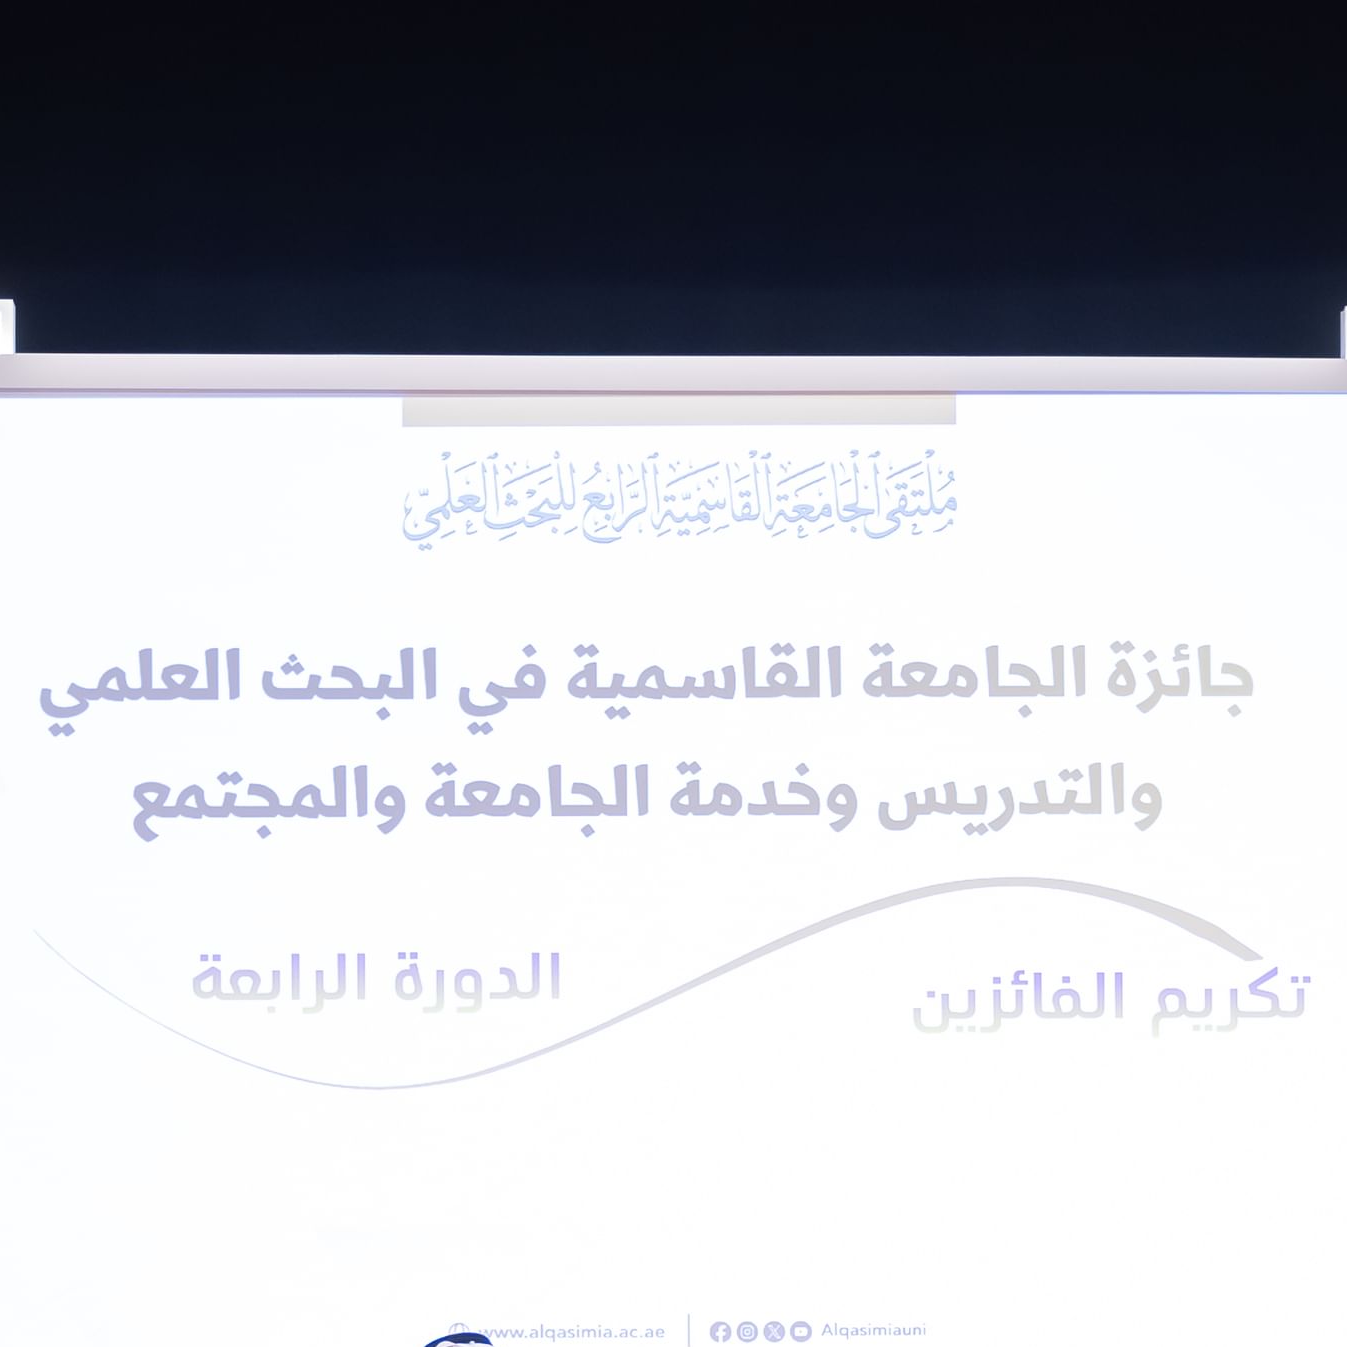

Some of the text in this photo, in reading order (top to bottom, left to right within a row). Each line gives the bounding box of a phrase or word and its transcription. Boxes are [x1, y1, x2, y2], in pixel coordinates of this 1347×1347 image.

[38, 640, 1255, 738] جائزة الجامعة القاسمية في البحث العلمي
[132, 760, 1164, 844] والتدريس وخدمة الجامعة والمجتمع
[190, 951, 562, 1016] الدورة الرابعة
[911, 966, 1313, 1038] تكريم الفائزين
[820, 1321, 927, 1341] Alqasimiauni
